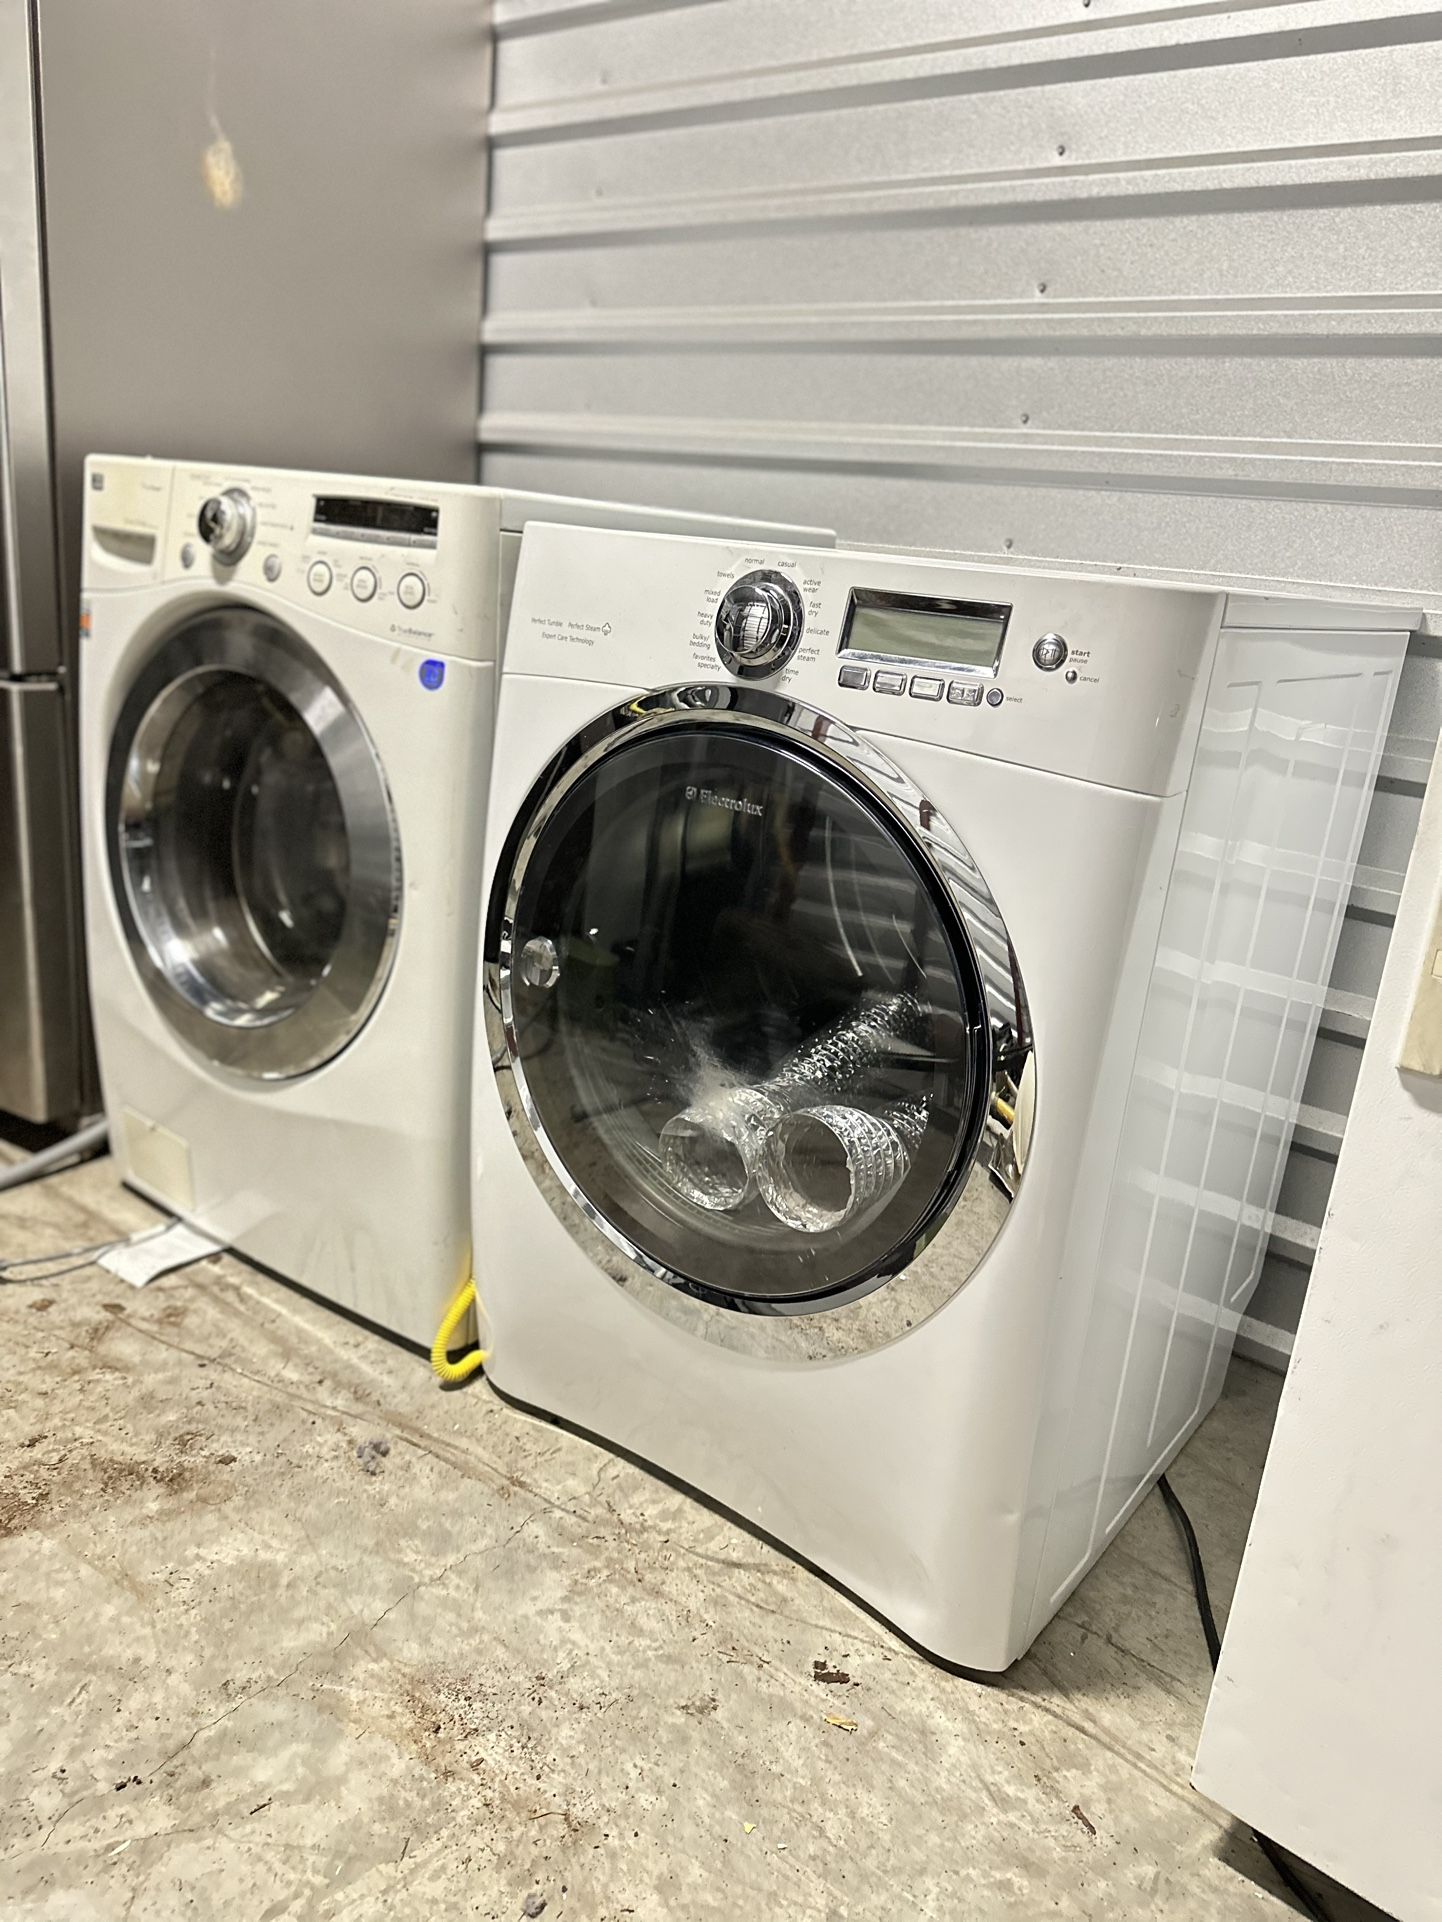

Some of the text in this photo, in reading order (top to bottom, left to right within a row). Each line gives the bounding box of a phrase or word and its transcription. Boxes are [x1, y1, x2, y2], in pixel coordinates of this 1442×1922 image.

[745, 557, 765, 565] normal
[777, 560, 797, 568] casual
[717, 570, 735, 579] towels
[803, 579, 821, 587] active
[704, 588, 721, 596] mixed
[706, 596, 718, 604] load
[809, 601, 822, 609] fast
[697, 611, 713, 620] heavy
[808, 609, 819, 617] dry
[568, 621, 584, 630] Perfect
[700, 618, 712, 627] duty
[806, 627, 830, 636] delicate
[569, 635, 594, 647] Technology
[689, 641, 711, 650] bedding
[798, 647, 820, 656] perfect
[1070, 649, 1091, 657] start
[692, 652, 716, 662] favorites
[797, 654, 816, 662] steam
[697, 662, 721, 672] specialty
[1079, 675, 1100, 683] cancel
[1005, 695, 1023, 703] select
[700, 789, 763, 816] Electrolux
